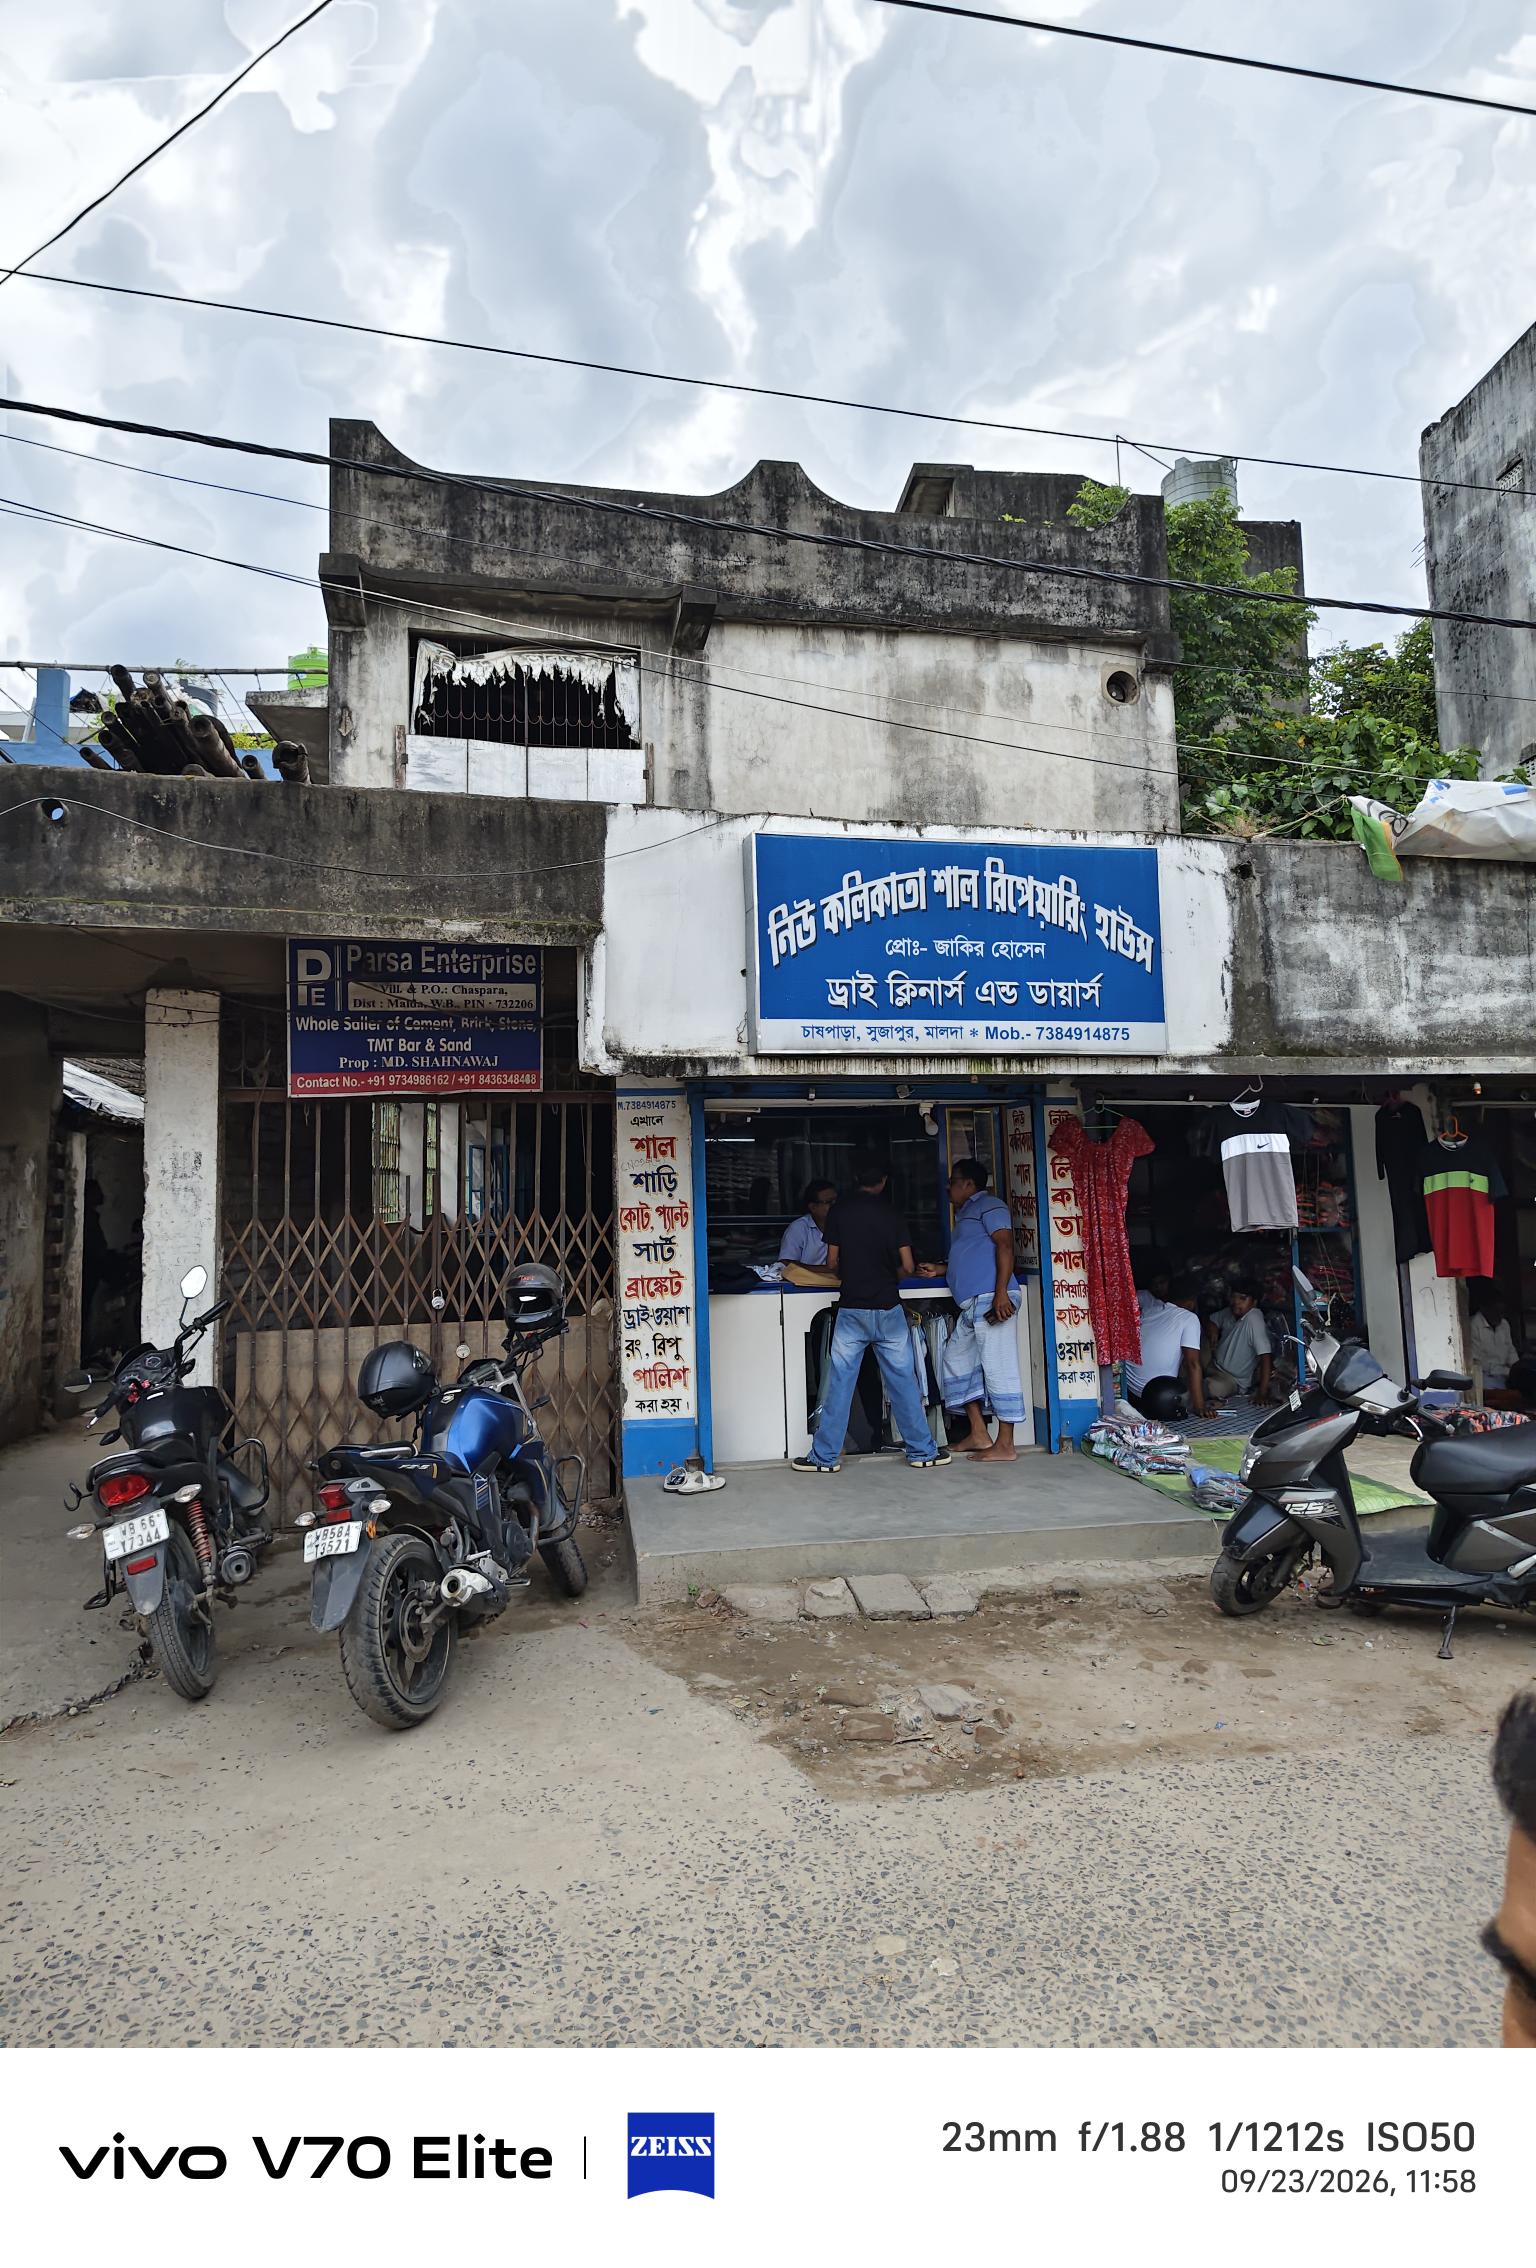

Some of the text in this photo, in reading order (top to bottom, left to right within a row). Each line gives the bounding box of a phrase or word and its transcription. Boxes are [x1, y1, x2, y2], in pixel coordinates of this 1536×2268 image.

[767, 857, 1154, 973] নিউ কলিকাতা শাল রিপেয়ারিং হাউস
[933, 936, 985, 958] জাকির
[992, 940, 1045, 960] হোসেন
[347, 944, 536, 981] Parsa Enterprise
[451, 985, 508, 997] Chaspara,
[826, 970, 1104, 1008] ড্রাই ক্লিনার্স এন্ড ডায়ার্স
[496, 1000, 534, 1009] 732206
[296, 1016, 339, 1031] Whole
[343, 1016, 380, 1031] Sailer
[386, 1016, 400, 1031] of
[403, 1016, 457, 1033] Cement,
[866, 1025, 919, 1042] সুজাপুর,
[924, 1025, 963, 1040] মালদা
[985, 1025, 1031, 1041] Mob.-
[1035, 1026, 1130, 1040] 7384914875
[367, 1037, 472, 1052] TMT Bar & Sand
[339, 1057, 370, 1071] Prop
[381, 1056, 408, 1068] MD.
[412, 1055, 499, 1068] SHAHNAWAJ
[297, 1076, 340, 1088] Contact
[367, 1075, 385, 1086] +91
[388, 1074, 449, 1086] 9734986162
[458, 1074, 476, 1085] +91
[630, 1115, 664, 1127] এখানে
[630, 1134, 676, 1160] শাল
[630, 1165, 678, 1198] শাড়ি
[655, 1199, 689, 1232] প্যান্ট
[632, 1235, 676, 1262] সার্ট
[1051, 1249, 1086, 1270] শাল
[1055, 1304, 1091, 1328] হাউস
[652, 1332, 684, 1361] রিপু
[1056, 1339, 1095, 1362] ওয়াশ
[633, 1362, 690, 1390] পালিশ
[1057, 1371, 1077, 1384] করা
[635, 1399, 658, 1413] করা
